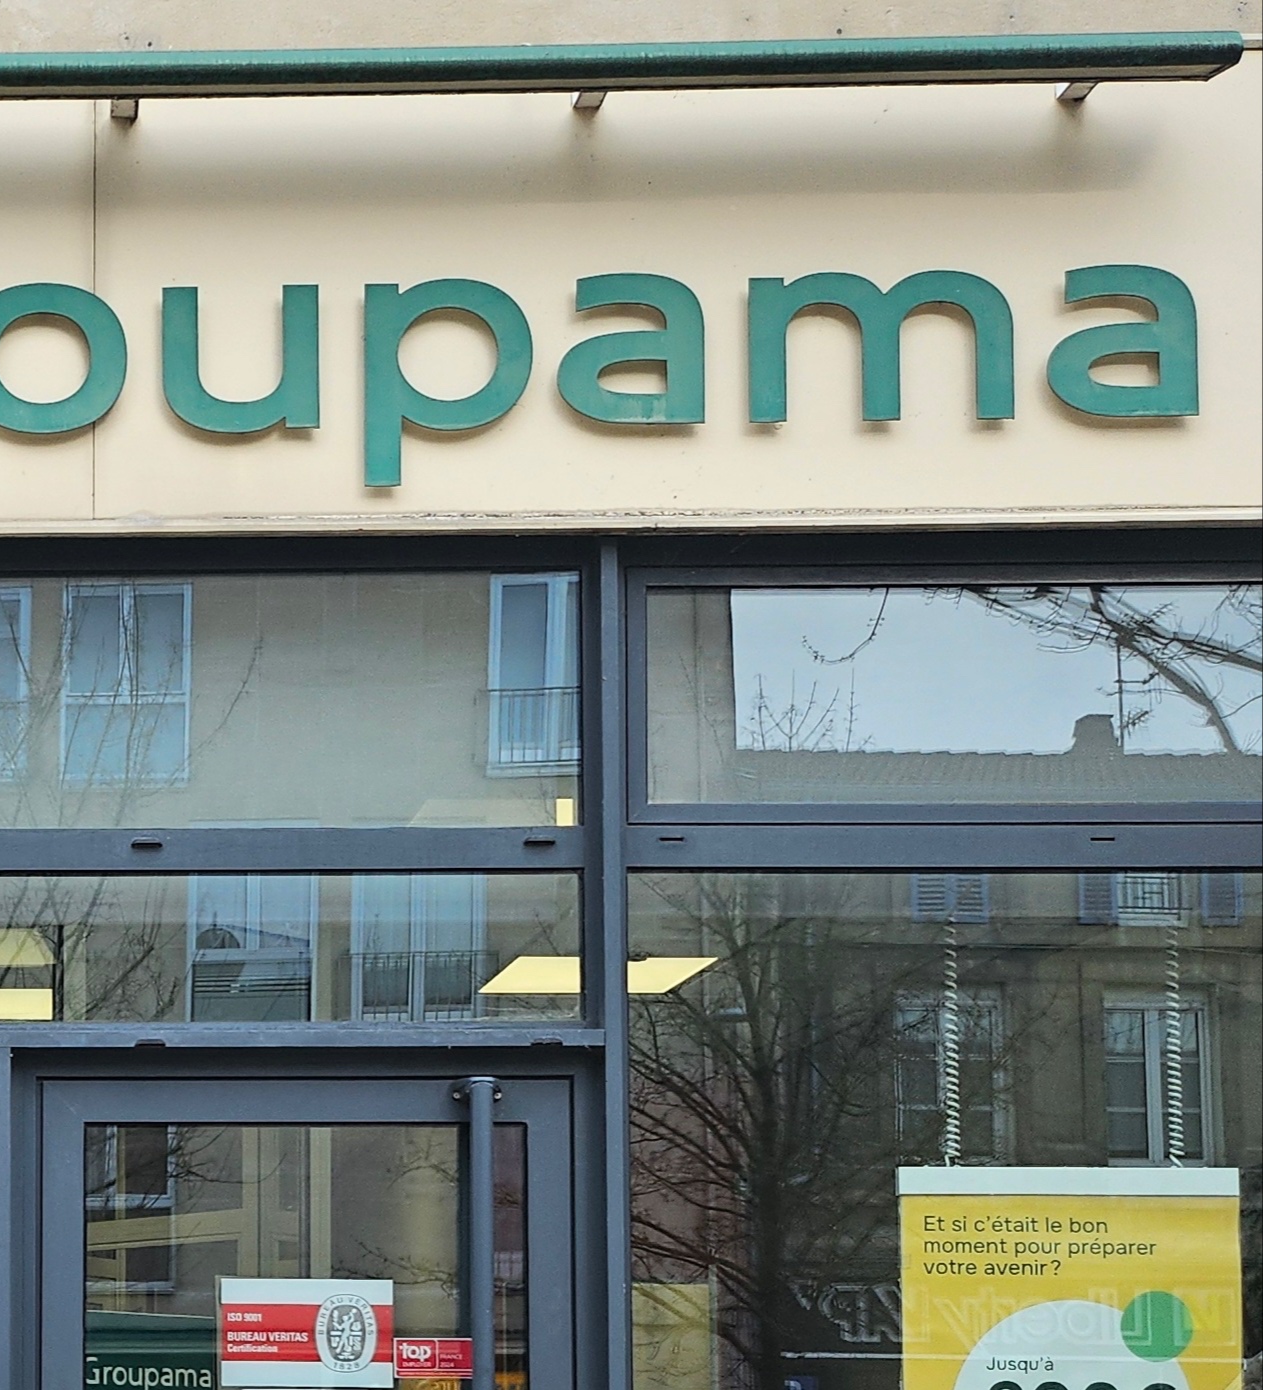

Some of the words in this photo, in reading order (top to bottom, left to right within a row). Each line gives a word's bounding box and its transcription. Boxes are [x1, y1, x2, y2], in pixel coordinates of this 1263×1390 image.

[923, 1215, 945, 1232] Et
[951, 1216, 967, 1233] si
[974, 1215, 1039, 1233] c'était
[1045, 1217, 1062, 1233] le
[1069, 1217, 1108, 1234] bon
[923, 1238, 1008, 1253] moment
[1014, 1241, 1062, 1258] pour
[1068, 1238, 1157, 1258] préparer
[923, 1260, 977, 1275] votre
[227, 1312, 242, 1322] ISO
[243, 1313, 262, 1322] 9001
[317, 1297, 343, 1335] BUREAU
[347, 1297, 374, 1336] VERITAS
[227, 1331, 267, 1342] BUREAU
[267, 1331, 309, 1342] VERITAS
[227, 1343, 279, 1353] Certification
[333, 1362, 361, 1370] 1828
[986, 1357, 1054, 1374] Jusqu'à
